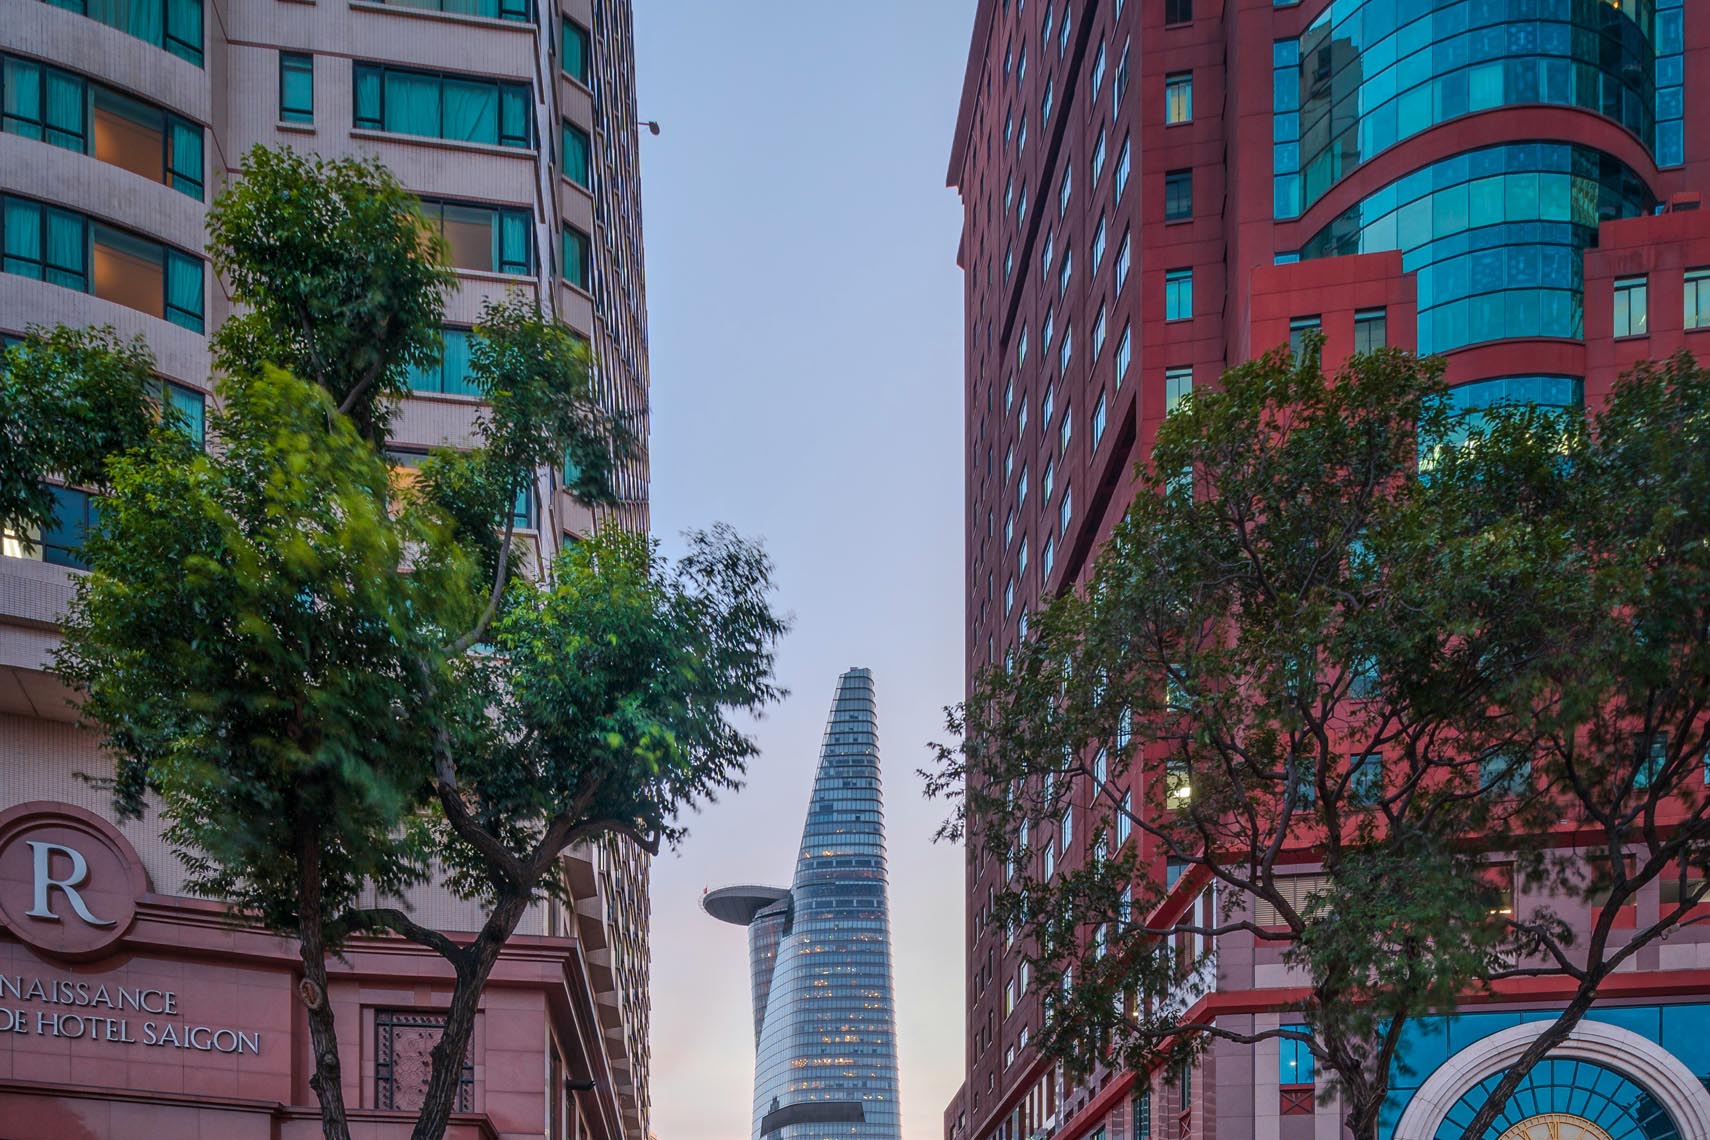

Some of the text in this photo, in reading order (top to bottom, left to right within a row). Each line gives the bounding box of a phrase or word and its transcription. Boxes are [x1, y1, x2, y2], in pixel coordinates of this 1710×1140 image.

[26, 840, 117, 926] R
[37, 1011, 136, 1043] HOTEL
[143, 1021, 260, 1055] SAIGON
